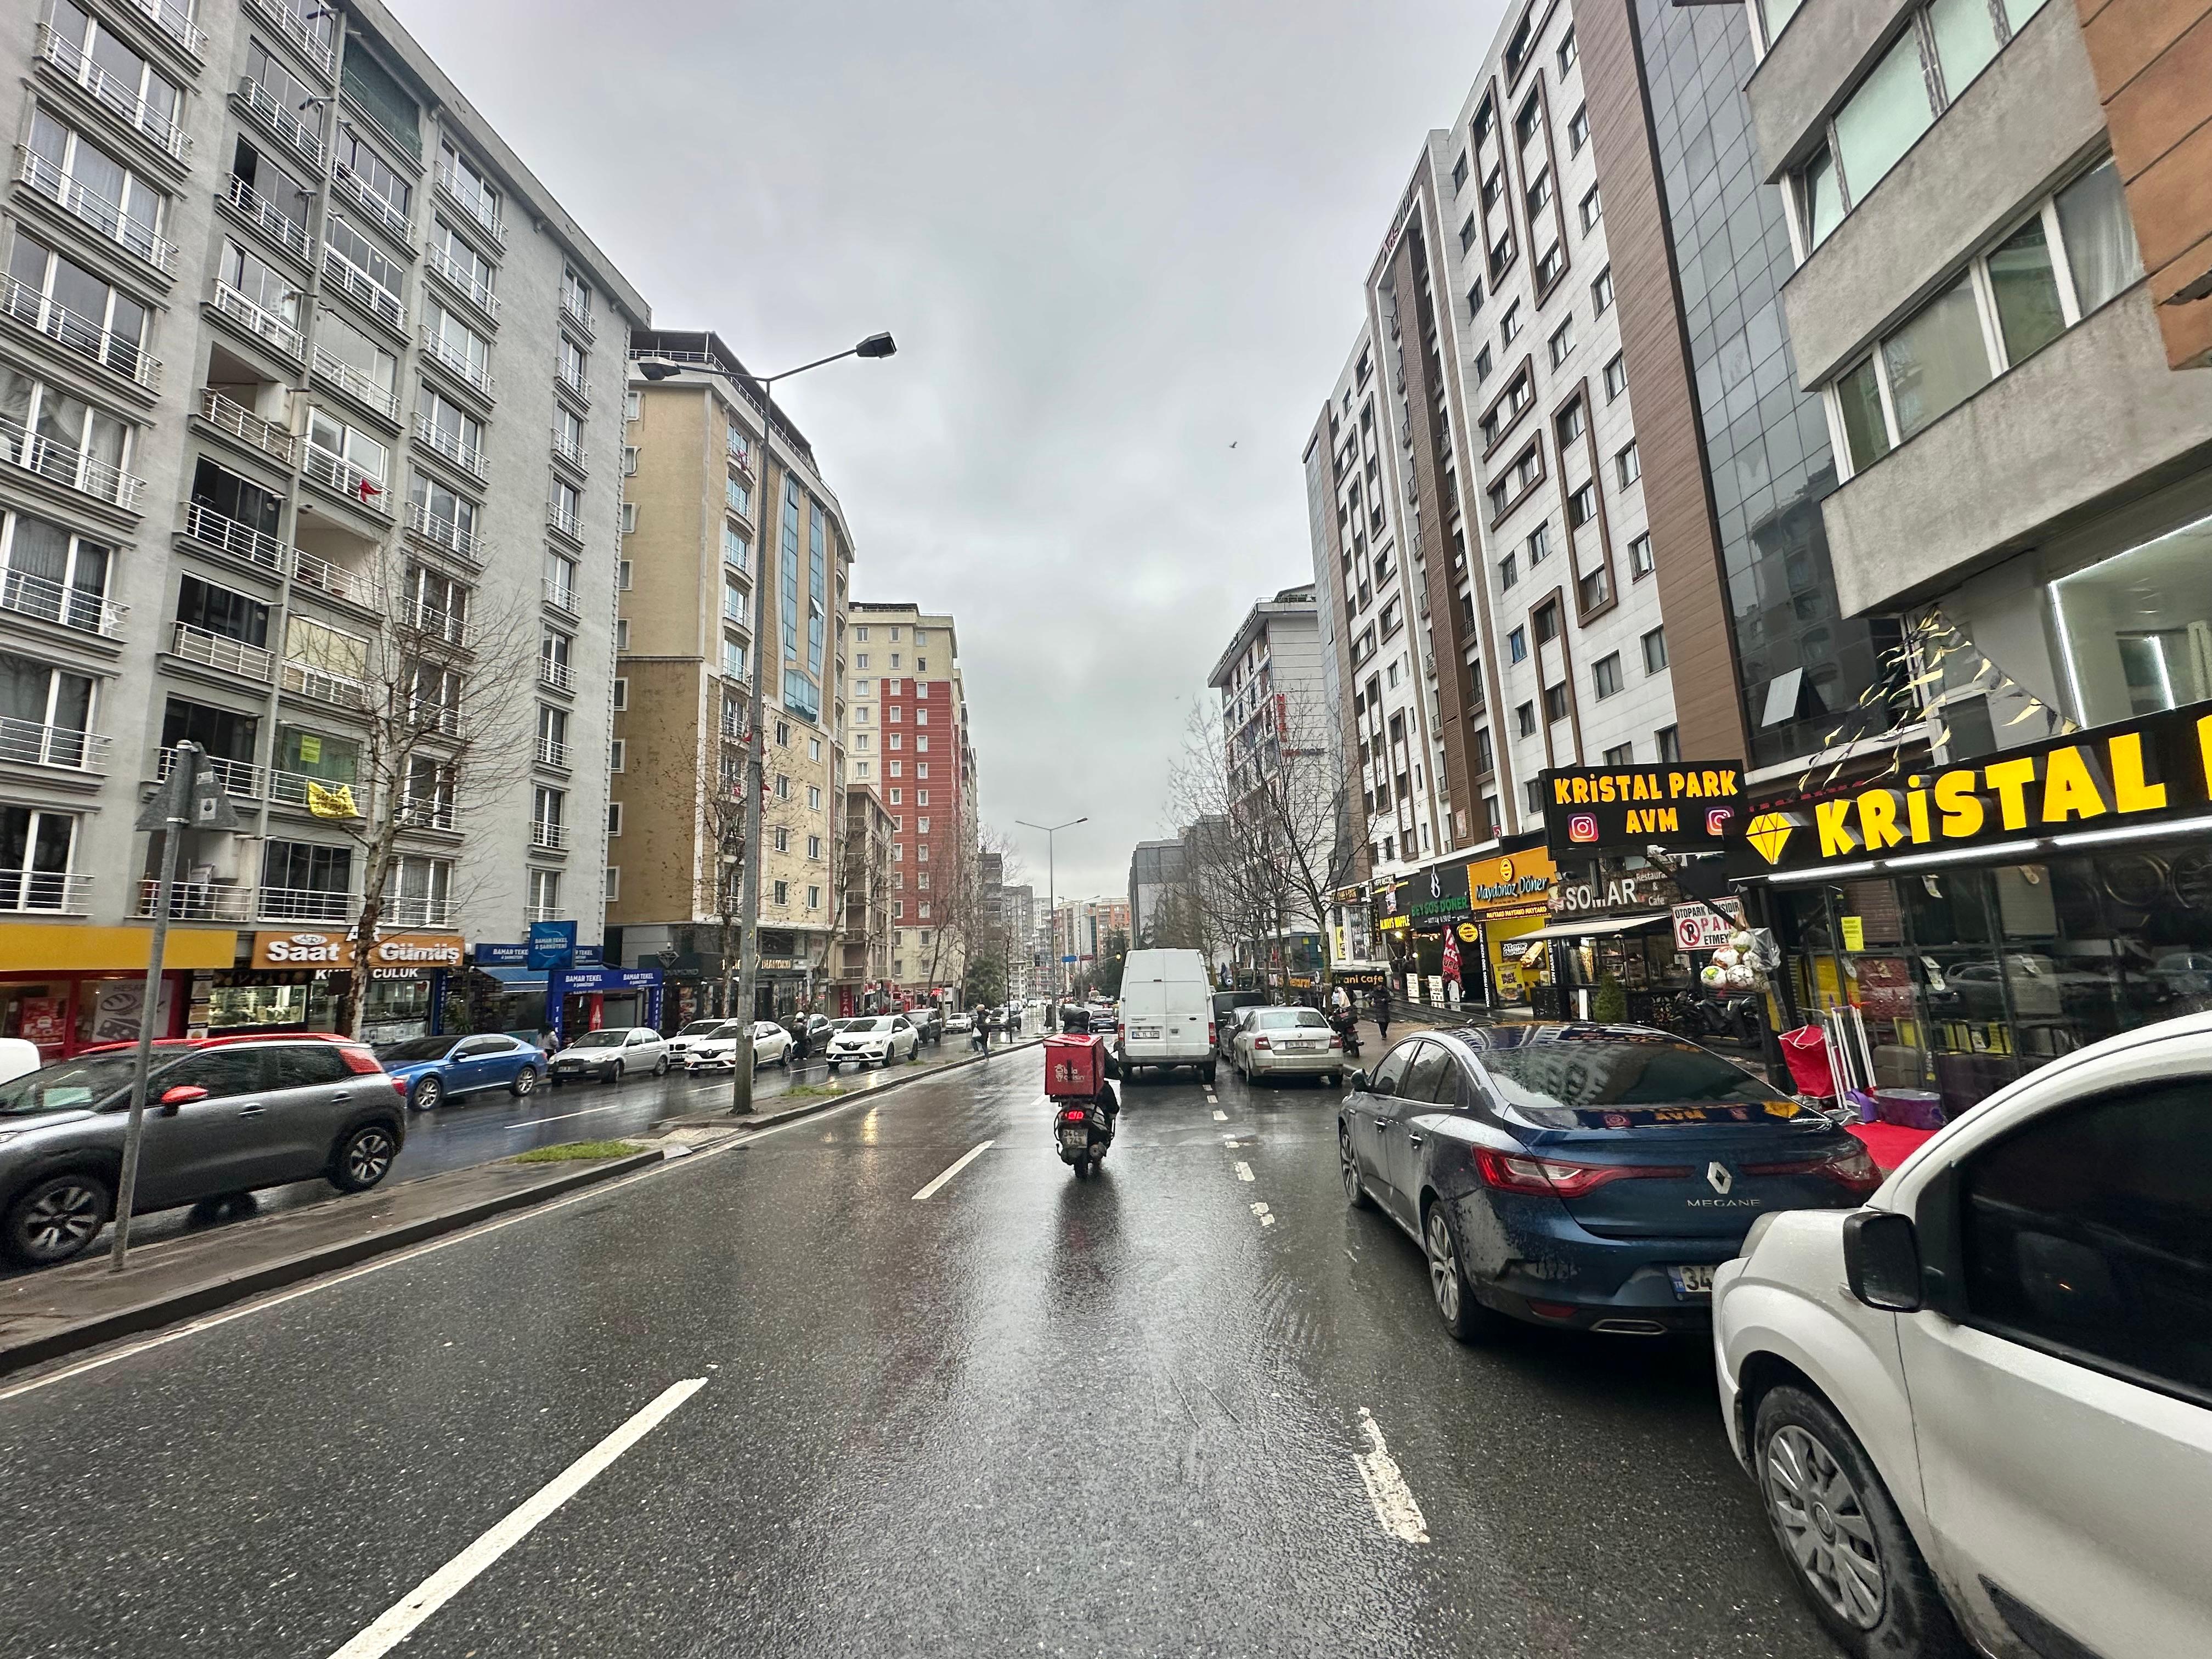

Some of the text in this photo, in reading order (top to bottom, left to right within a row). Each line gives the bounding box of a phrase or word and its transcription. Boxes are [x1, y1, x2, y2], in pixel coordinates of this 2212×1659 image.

[1669, 770, 1738, 797] PARK
[1626, 807, 1678, 834] AVM
[1519, 876, 1548, 893] Döner
[1652, 882, 1658, 890] &
[1566, 878, 1637, 910] SOAR
[1649, 895, 1665, 906] Cafe
[1675, 906, 1705, 918] OTOPARK
[1395, 915, 1410, 928] WAFFLE
[266, 941, 341, 961] Saat
[379, 943, 460, 964] Gümüş
[1687, 1199, 1760, 1207] MEGANE
